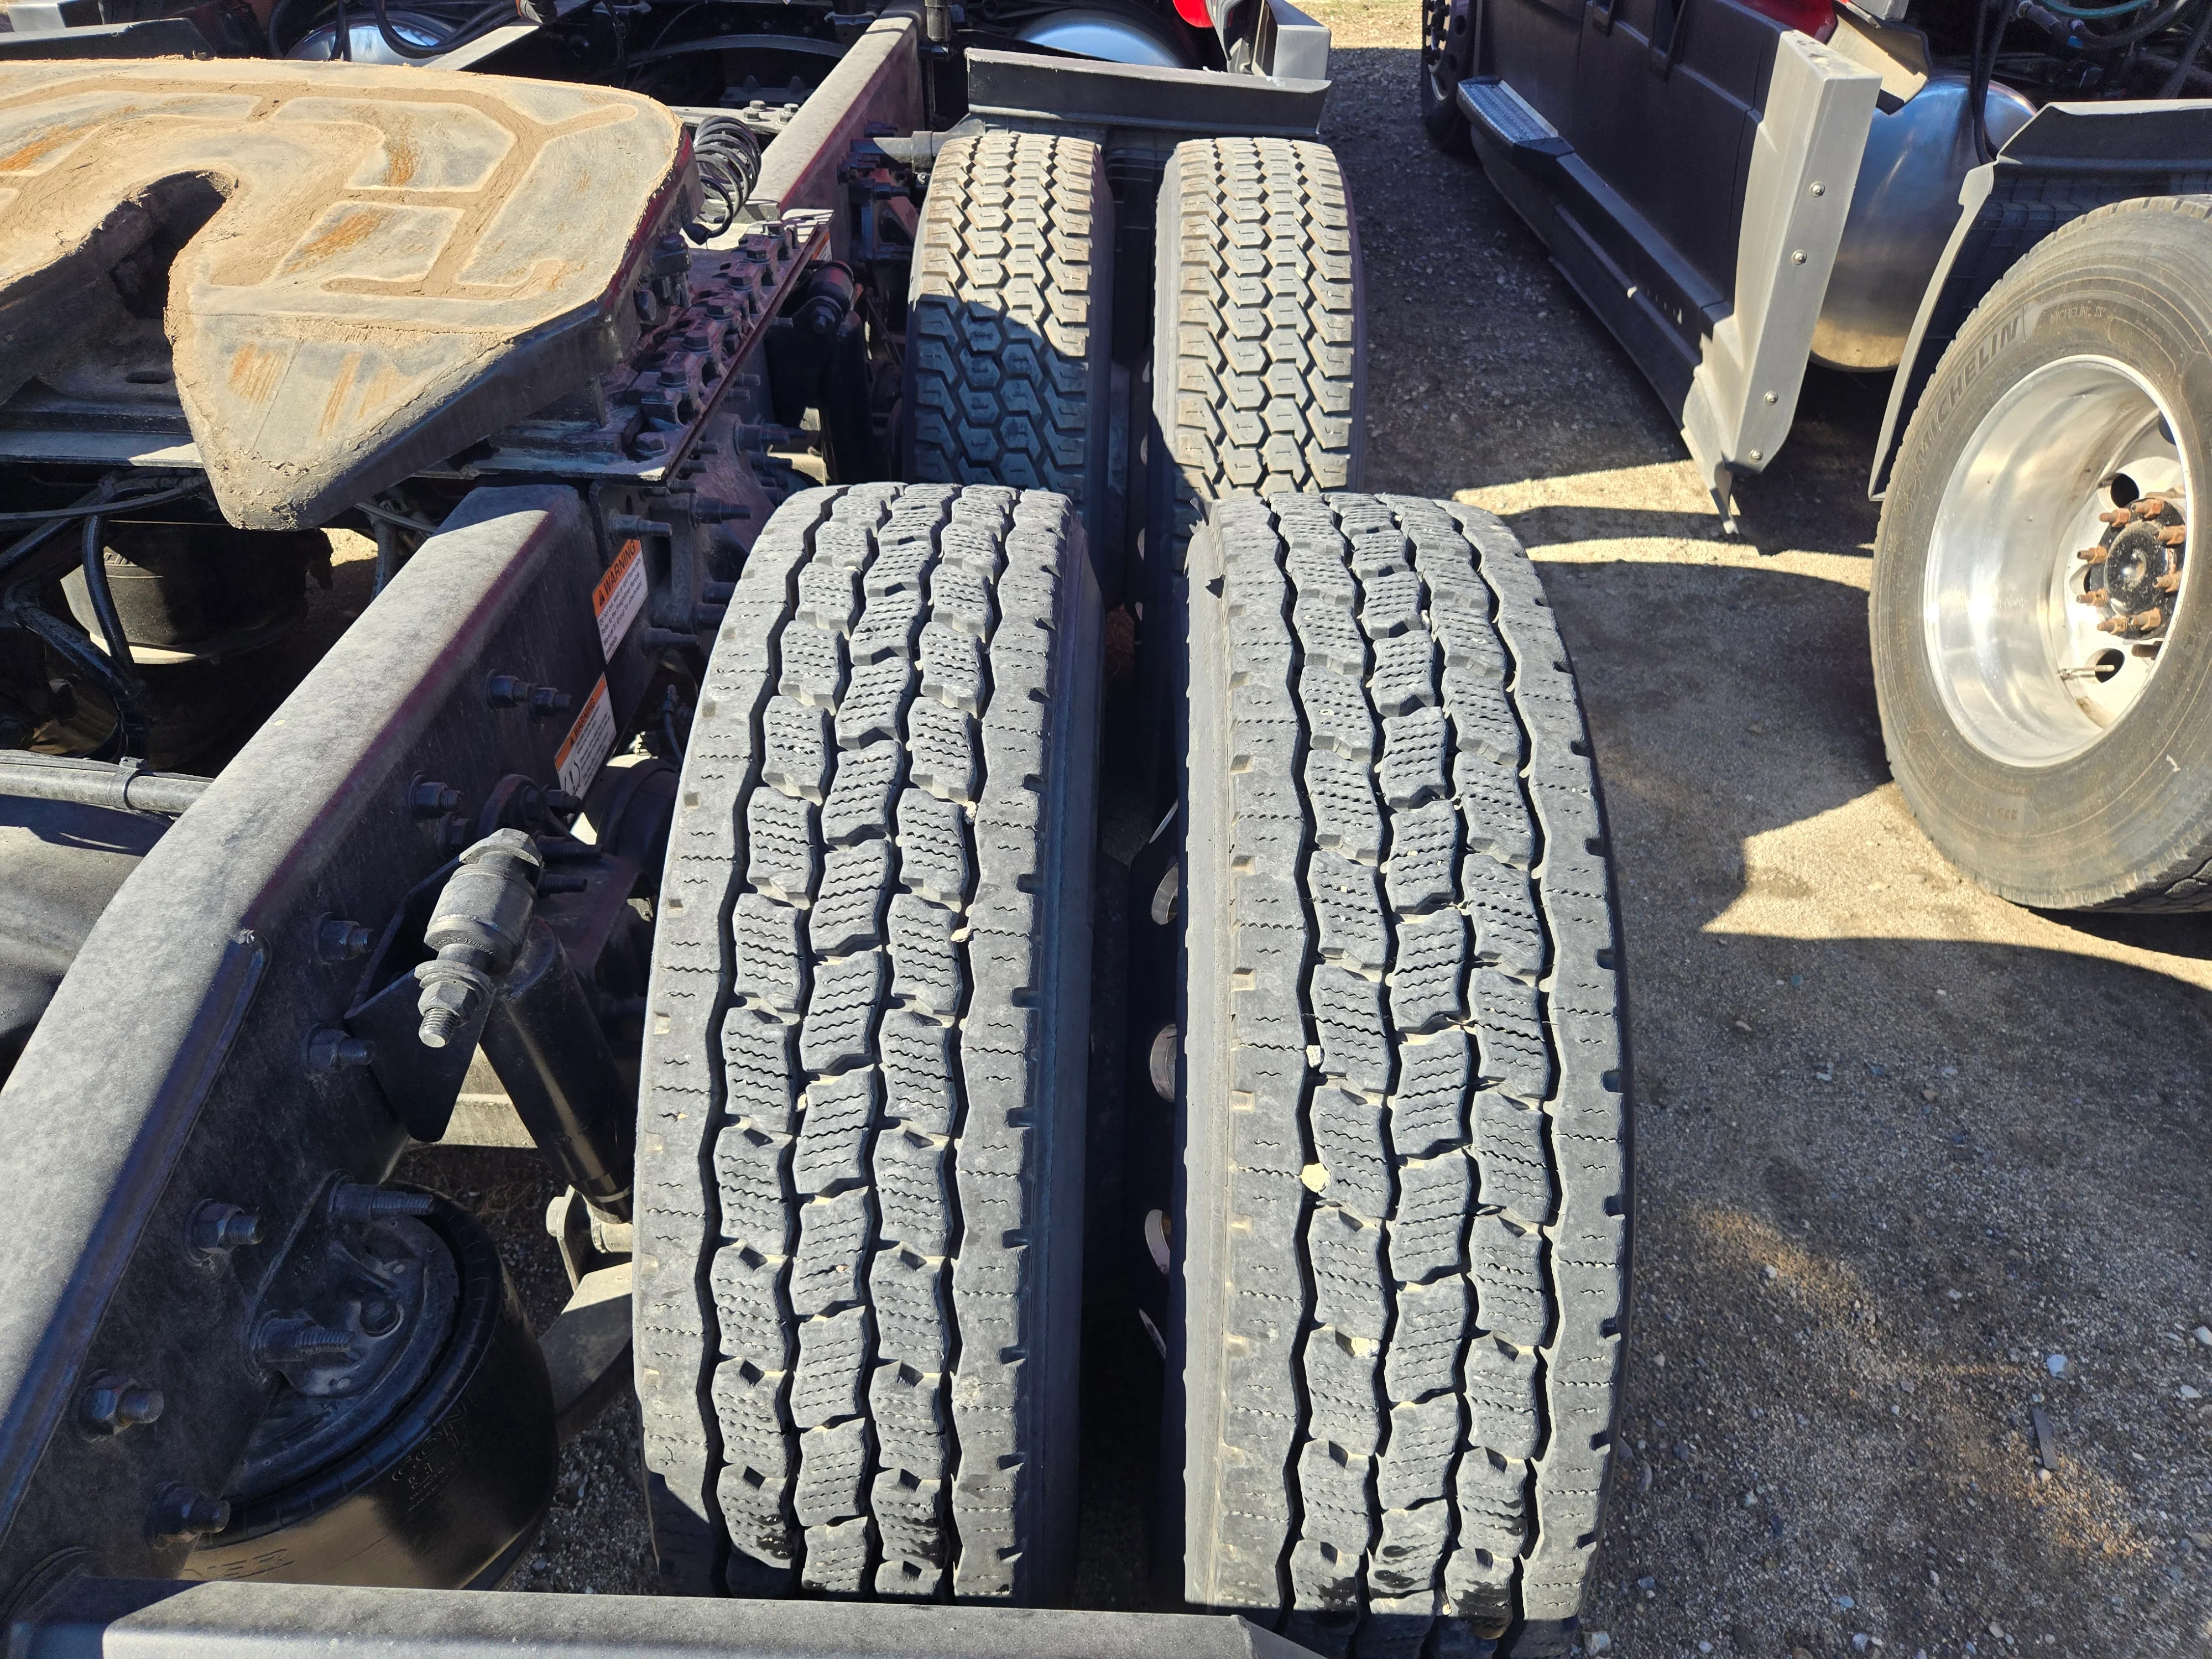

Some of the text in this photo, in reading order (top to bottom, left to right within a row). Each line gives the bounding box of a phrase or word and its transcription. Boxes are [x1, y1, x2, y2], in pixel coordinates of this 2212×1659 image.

[1914, 315, 2019, 474] MICHELIN
[603, 539, 636, 594] WARNING
[573, 697, 595, 738] WARNING
